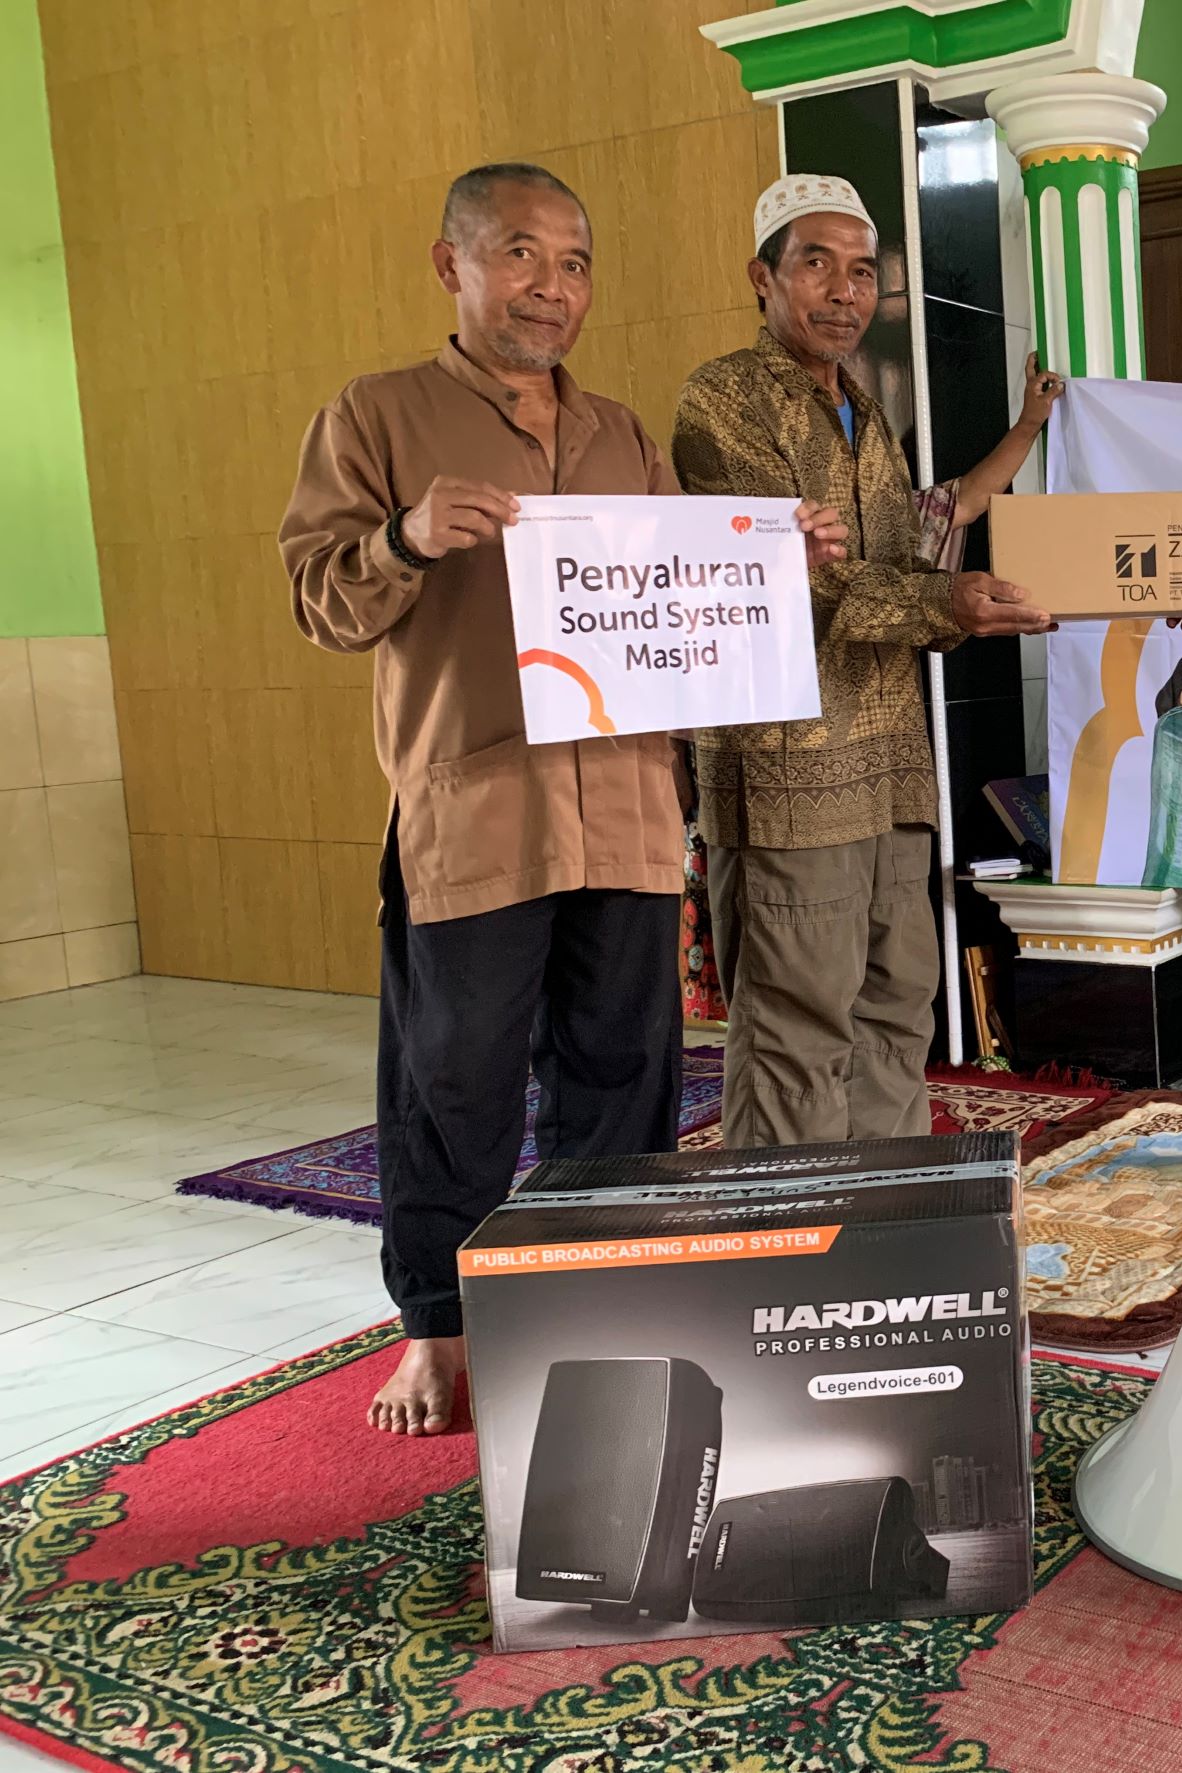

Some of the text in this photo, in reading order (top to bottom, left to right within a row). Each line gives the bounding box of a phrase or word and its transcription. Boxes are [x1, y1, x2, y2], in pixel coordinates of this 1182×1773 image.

[556, 555, 765, 600] Penyaluran
[1117, 584, 1157, 602] TOA
[560, 601, 770, 634] Sound System
[625, 640, 719, 675] Masjid
[472, 1232, 820, 1268] PUBLIC BROADCASTING AUDIO SYSTEM
[755, 1323, 1012, 1355] PROFESSIONAL AUDIO
[817, 1370, 955, 1395] Legendvoice-601
[687, 1446, 719, 1559] HARDWELL
